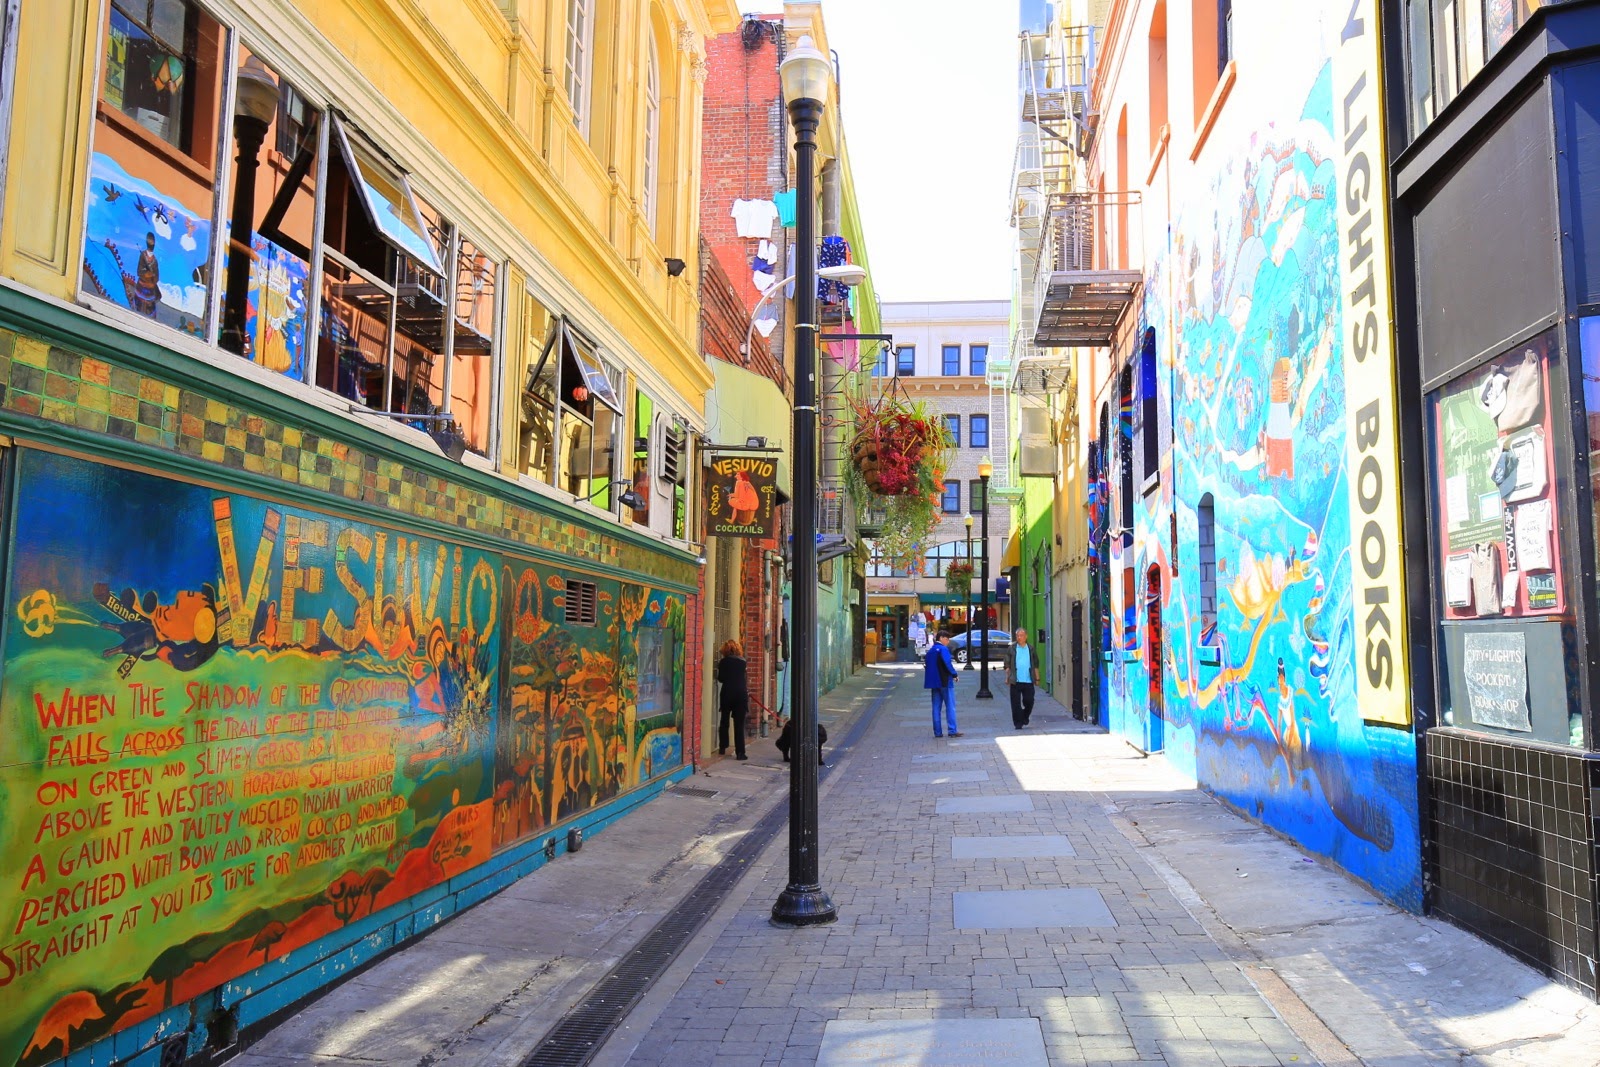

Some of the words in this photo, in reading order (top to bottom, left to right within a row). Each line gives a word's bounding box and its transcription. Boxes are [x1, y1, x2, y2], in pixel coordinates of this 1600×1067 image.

[1343, 69, 1379, 363] LIGHTS
[712, 459, 773, 477] VESUVIO
[715, 524, 764, 534] COCKTAILS
[1355, 398, 1393, 692] BOOKS
[1505, 527, 1517, 571] HOWL
[212, 497, 497, 658] VESUVIO
[1467, 650, 1485, 661] CITY
[1489, 650, 1522, 663] LIGHTS
[1475, 673, 1511, 687] POCKET
[34, 688, 115, 729] WHEN
[128, 683, 165, 719] THE
[185, 681, 262, 713] SHADOW
[271, 685, 287, 706] OF
[298, 684, 320, 706] THE
[330, 678, 409, 706] GRASSHOPPER
[36, 778, 77, 806] ON
[89, 766, 153, 797] GREEN
[161, 761, 186, 779] AND
[256, 740, 301, 766] GRASS
[307, 735, 325, 758] AS
[341, 733, 367, 753] RED
[47, 731, 110, 767] FALLS
[119, 727, 185, 758] ACROSS
[194, 719, 219, 743] THE
[265, 716, 281, 736] OF
[288, 712, 309, 733] THE
[356, 707, 394, 729] MOUSE
[21, 853, 46, 891] A
[58, 827, 134, 876] GAUNT
[140, 824, 174, 850] AND
[180, 809, 234, 842] TAUTLY
[238, 797, 299, 827] MUSCLED
[346, 774, 395, 802] WARRIOR
[34, 801, 113, 844] ABOVE
[122, 790, 151, 818] THE
[157, 780, 234, 817] WESTERN
[243, 768, 299, 797] HORIZON
[451, 806, 478, 830] HOURS
[15, 872, 126, 935] PERCHED
[132, 852, 172, 889] WITH
[179, 841, 219, 871] BOW
[223, 837, 252, 861] AND
[256, 820, 300, 849] ARROW
[307, 813, 352, 837] COCKED
[357, 804, 375, 825] AND
[118, 905, 143, 934] AT
[150, 888, 183, 924] YOU
[265, 851, 290, 878] FOR
[297, 838, 346, 867] ANOTHER
